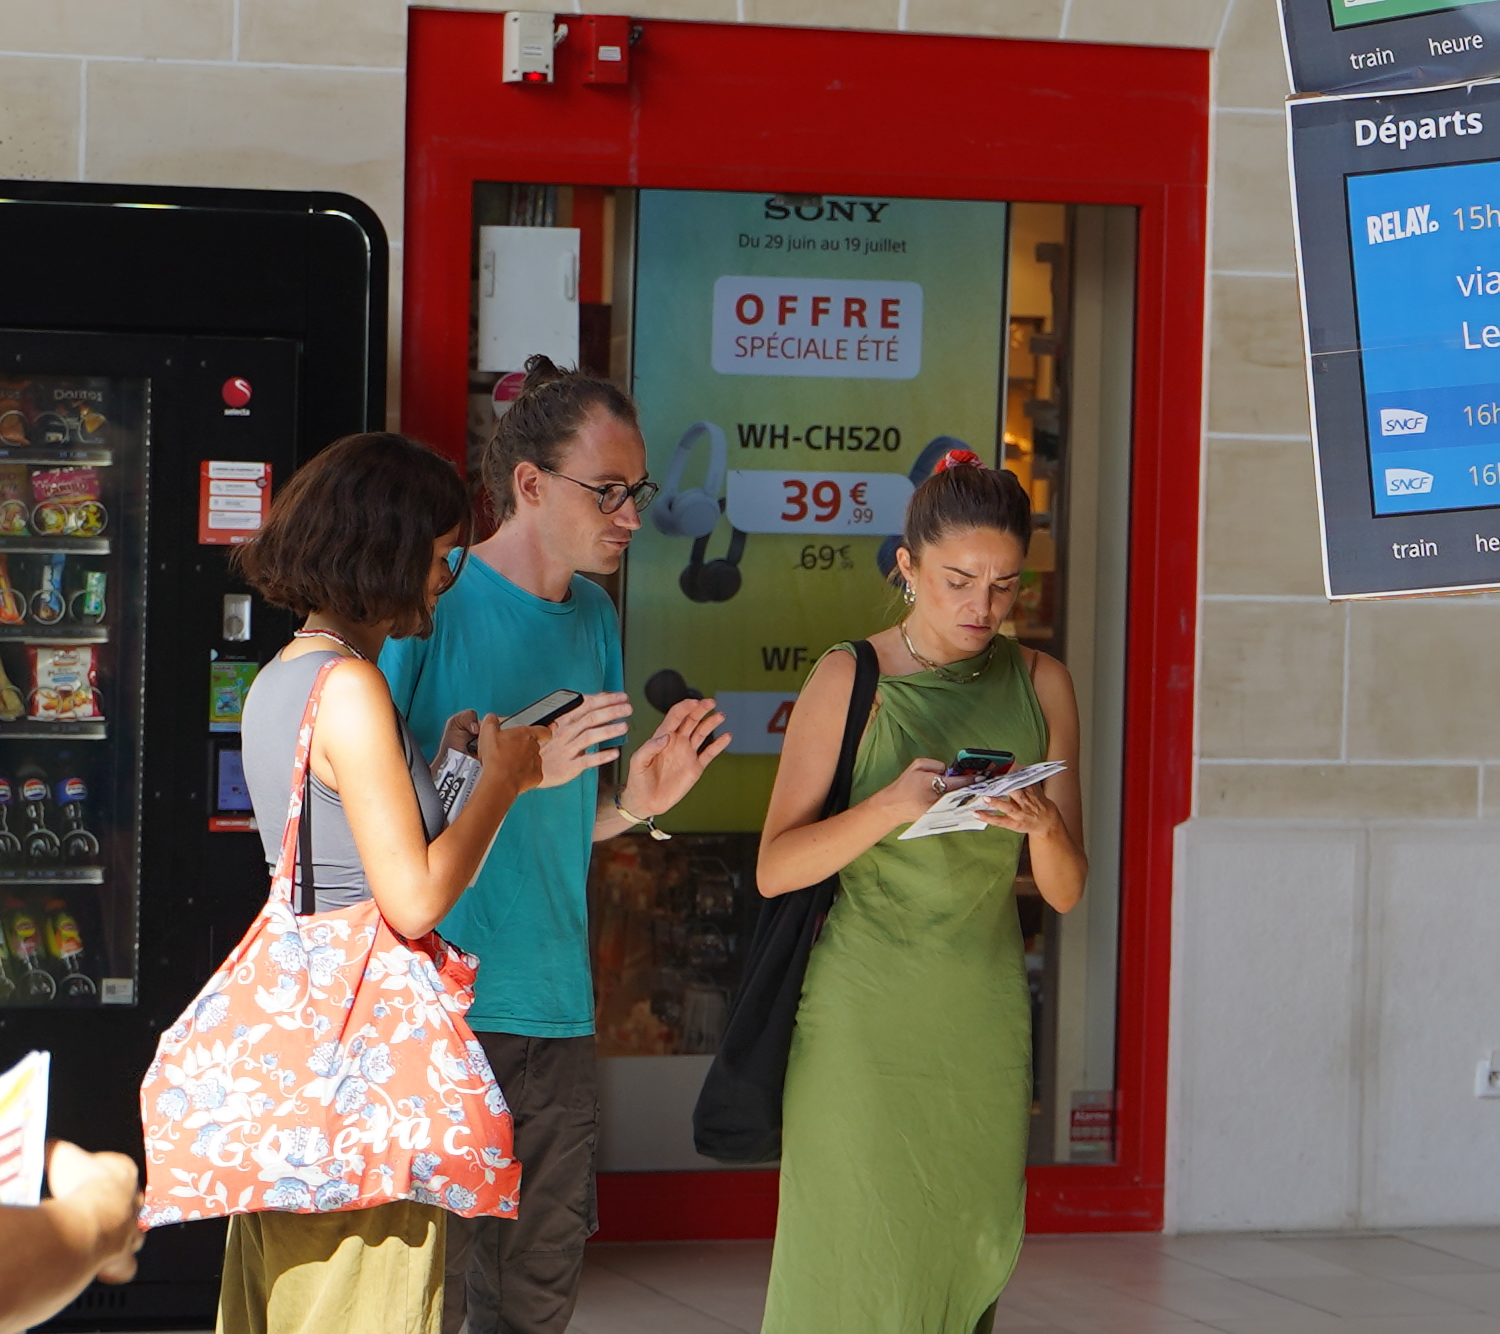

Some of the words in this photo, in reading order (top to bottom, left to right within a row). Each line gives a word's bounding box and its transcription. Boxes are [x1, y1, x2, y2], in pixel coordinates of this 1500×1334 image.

[1349, 48, 1395, 70] train
[1428, 33, 1484, 57] heure
[1354, 110, 1484, 151] Départs
[764, 197, 889, 223] SONY
[738, 234, 760, 249] Du
[764, 235, 783, 249] 29
[788, 236, 816, 252] juin
[820, 240, 839, 251] au
[845, 238, 860, 251] 19
[863, 240, 907, 255] juillet
[735, 293, 900, 329] OFFRE
[735, 332, 848, 360] SPÉCIALE
[856, 335, 899, 362] ÉTÉ
[738, 423, 901, 452] WH-CH520
[1384, 416, 1425, 433] SNCF
[1389, 476, 1431, 493] SNCF
[1391, 539, 1439, 559] train
